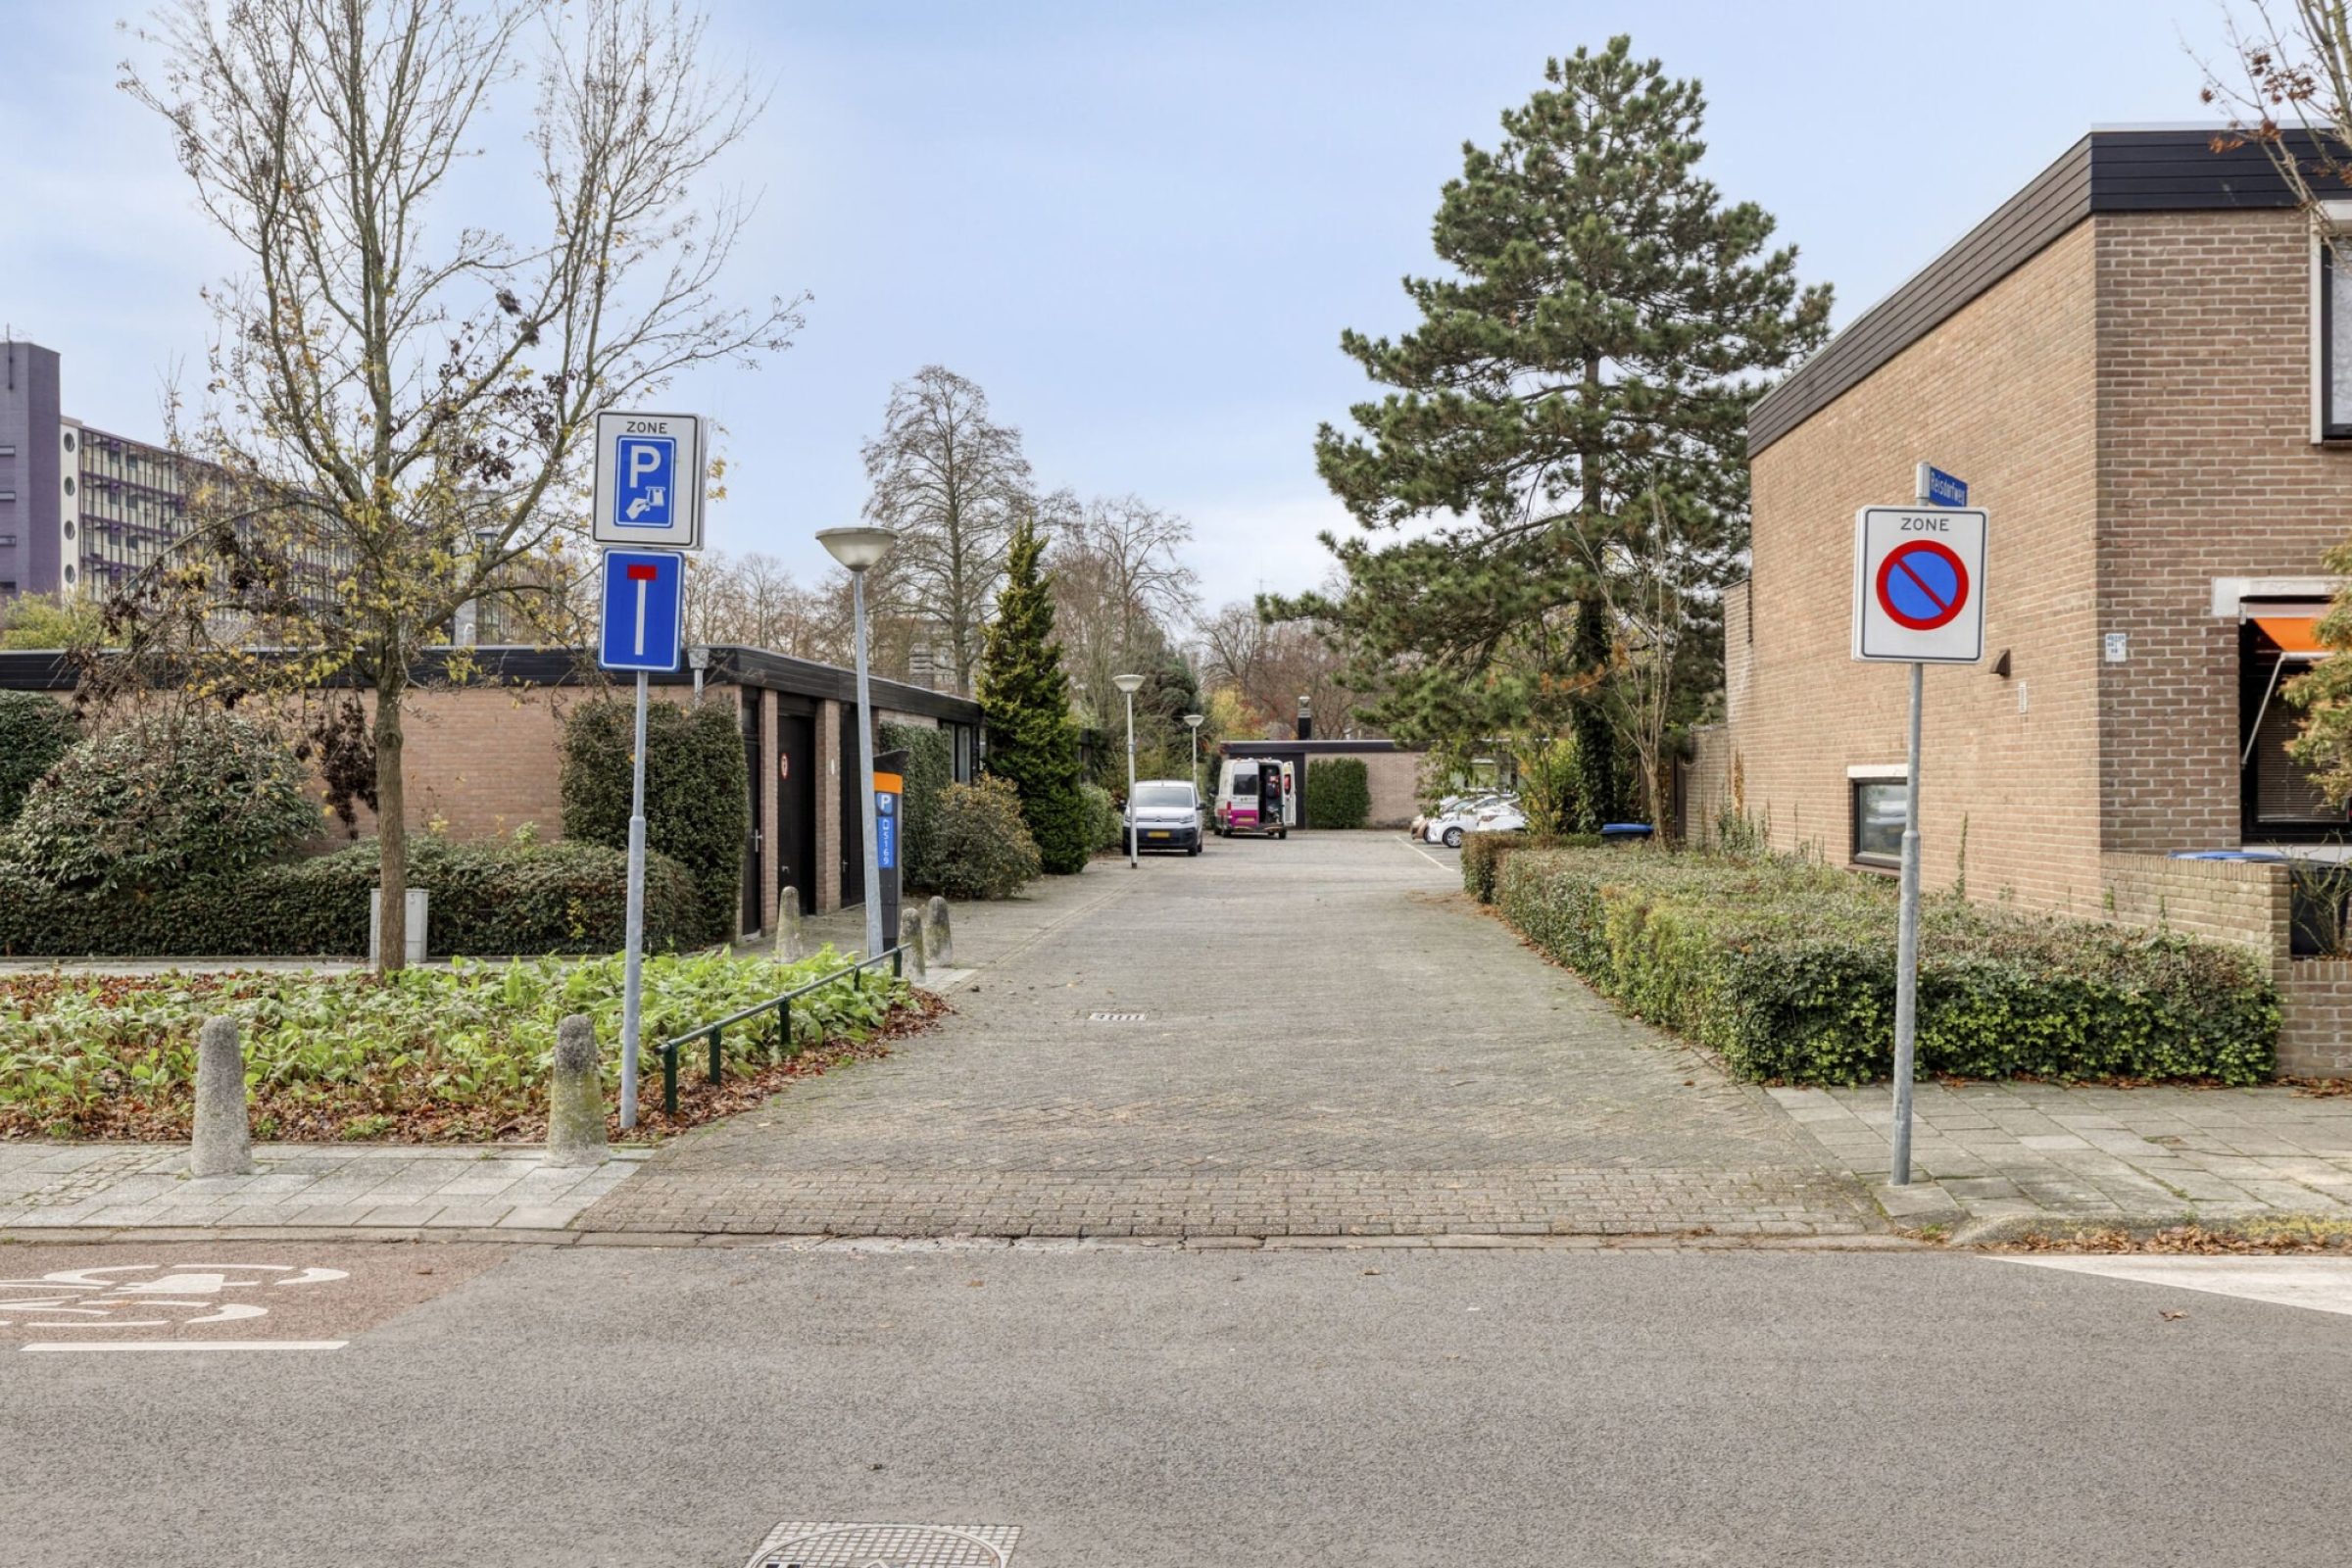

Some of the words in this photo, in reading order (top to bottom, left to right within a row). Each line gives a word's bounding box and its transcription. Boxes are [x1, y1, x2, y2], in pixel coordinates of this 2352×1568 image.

[626, 421, 668, 434] ZONE
[629, 445, 662, 488] P
[1900, 517, 1950, 531] ZONE
[881, 795, 892, 810] P
